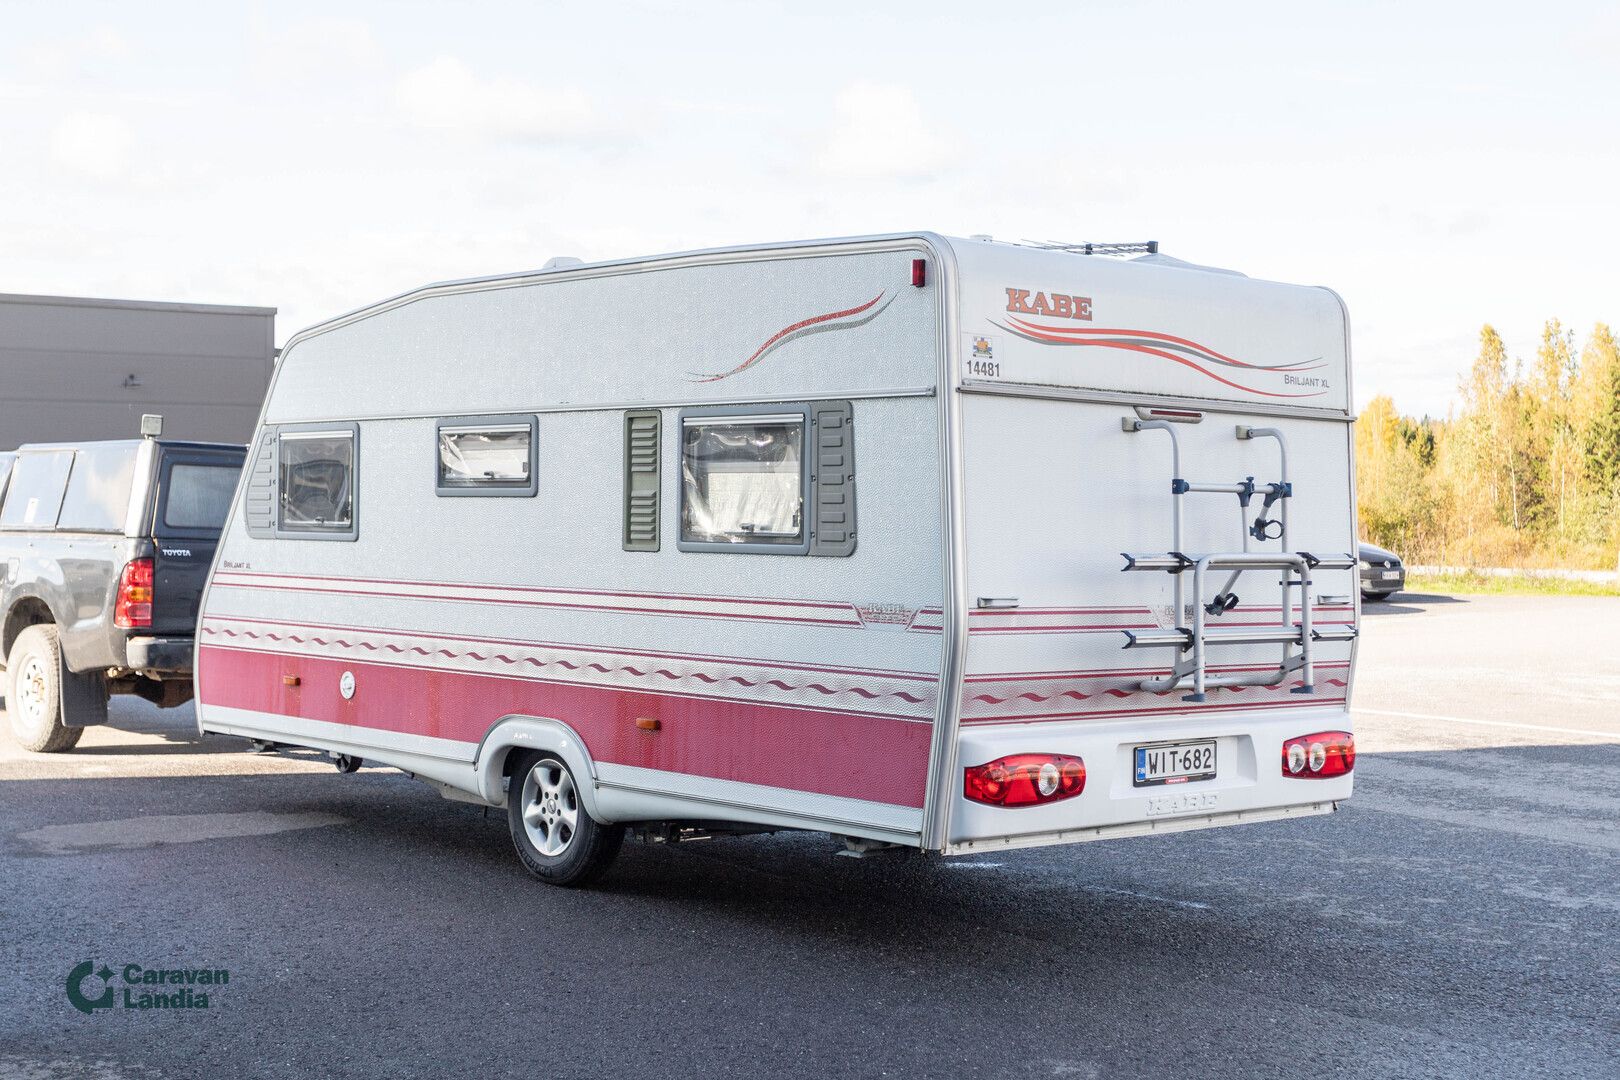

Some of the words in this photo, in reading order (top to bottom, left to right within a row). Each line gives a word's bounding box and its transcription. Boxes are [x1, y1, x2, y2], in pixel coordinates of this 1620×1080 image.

[1006, 287, 1092, 321] KABE
[967, 360, 1000, 377] 14481
[1320, 379, 1330, 388] XL
[162, 549, 191, 557] TOYOTA
[1148, 747, 1212, 775] WIT-682
